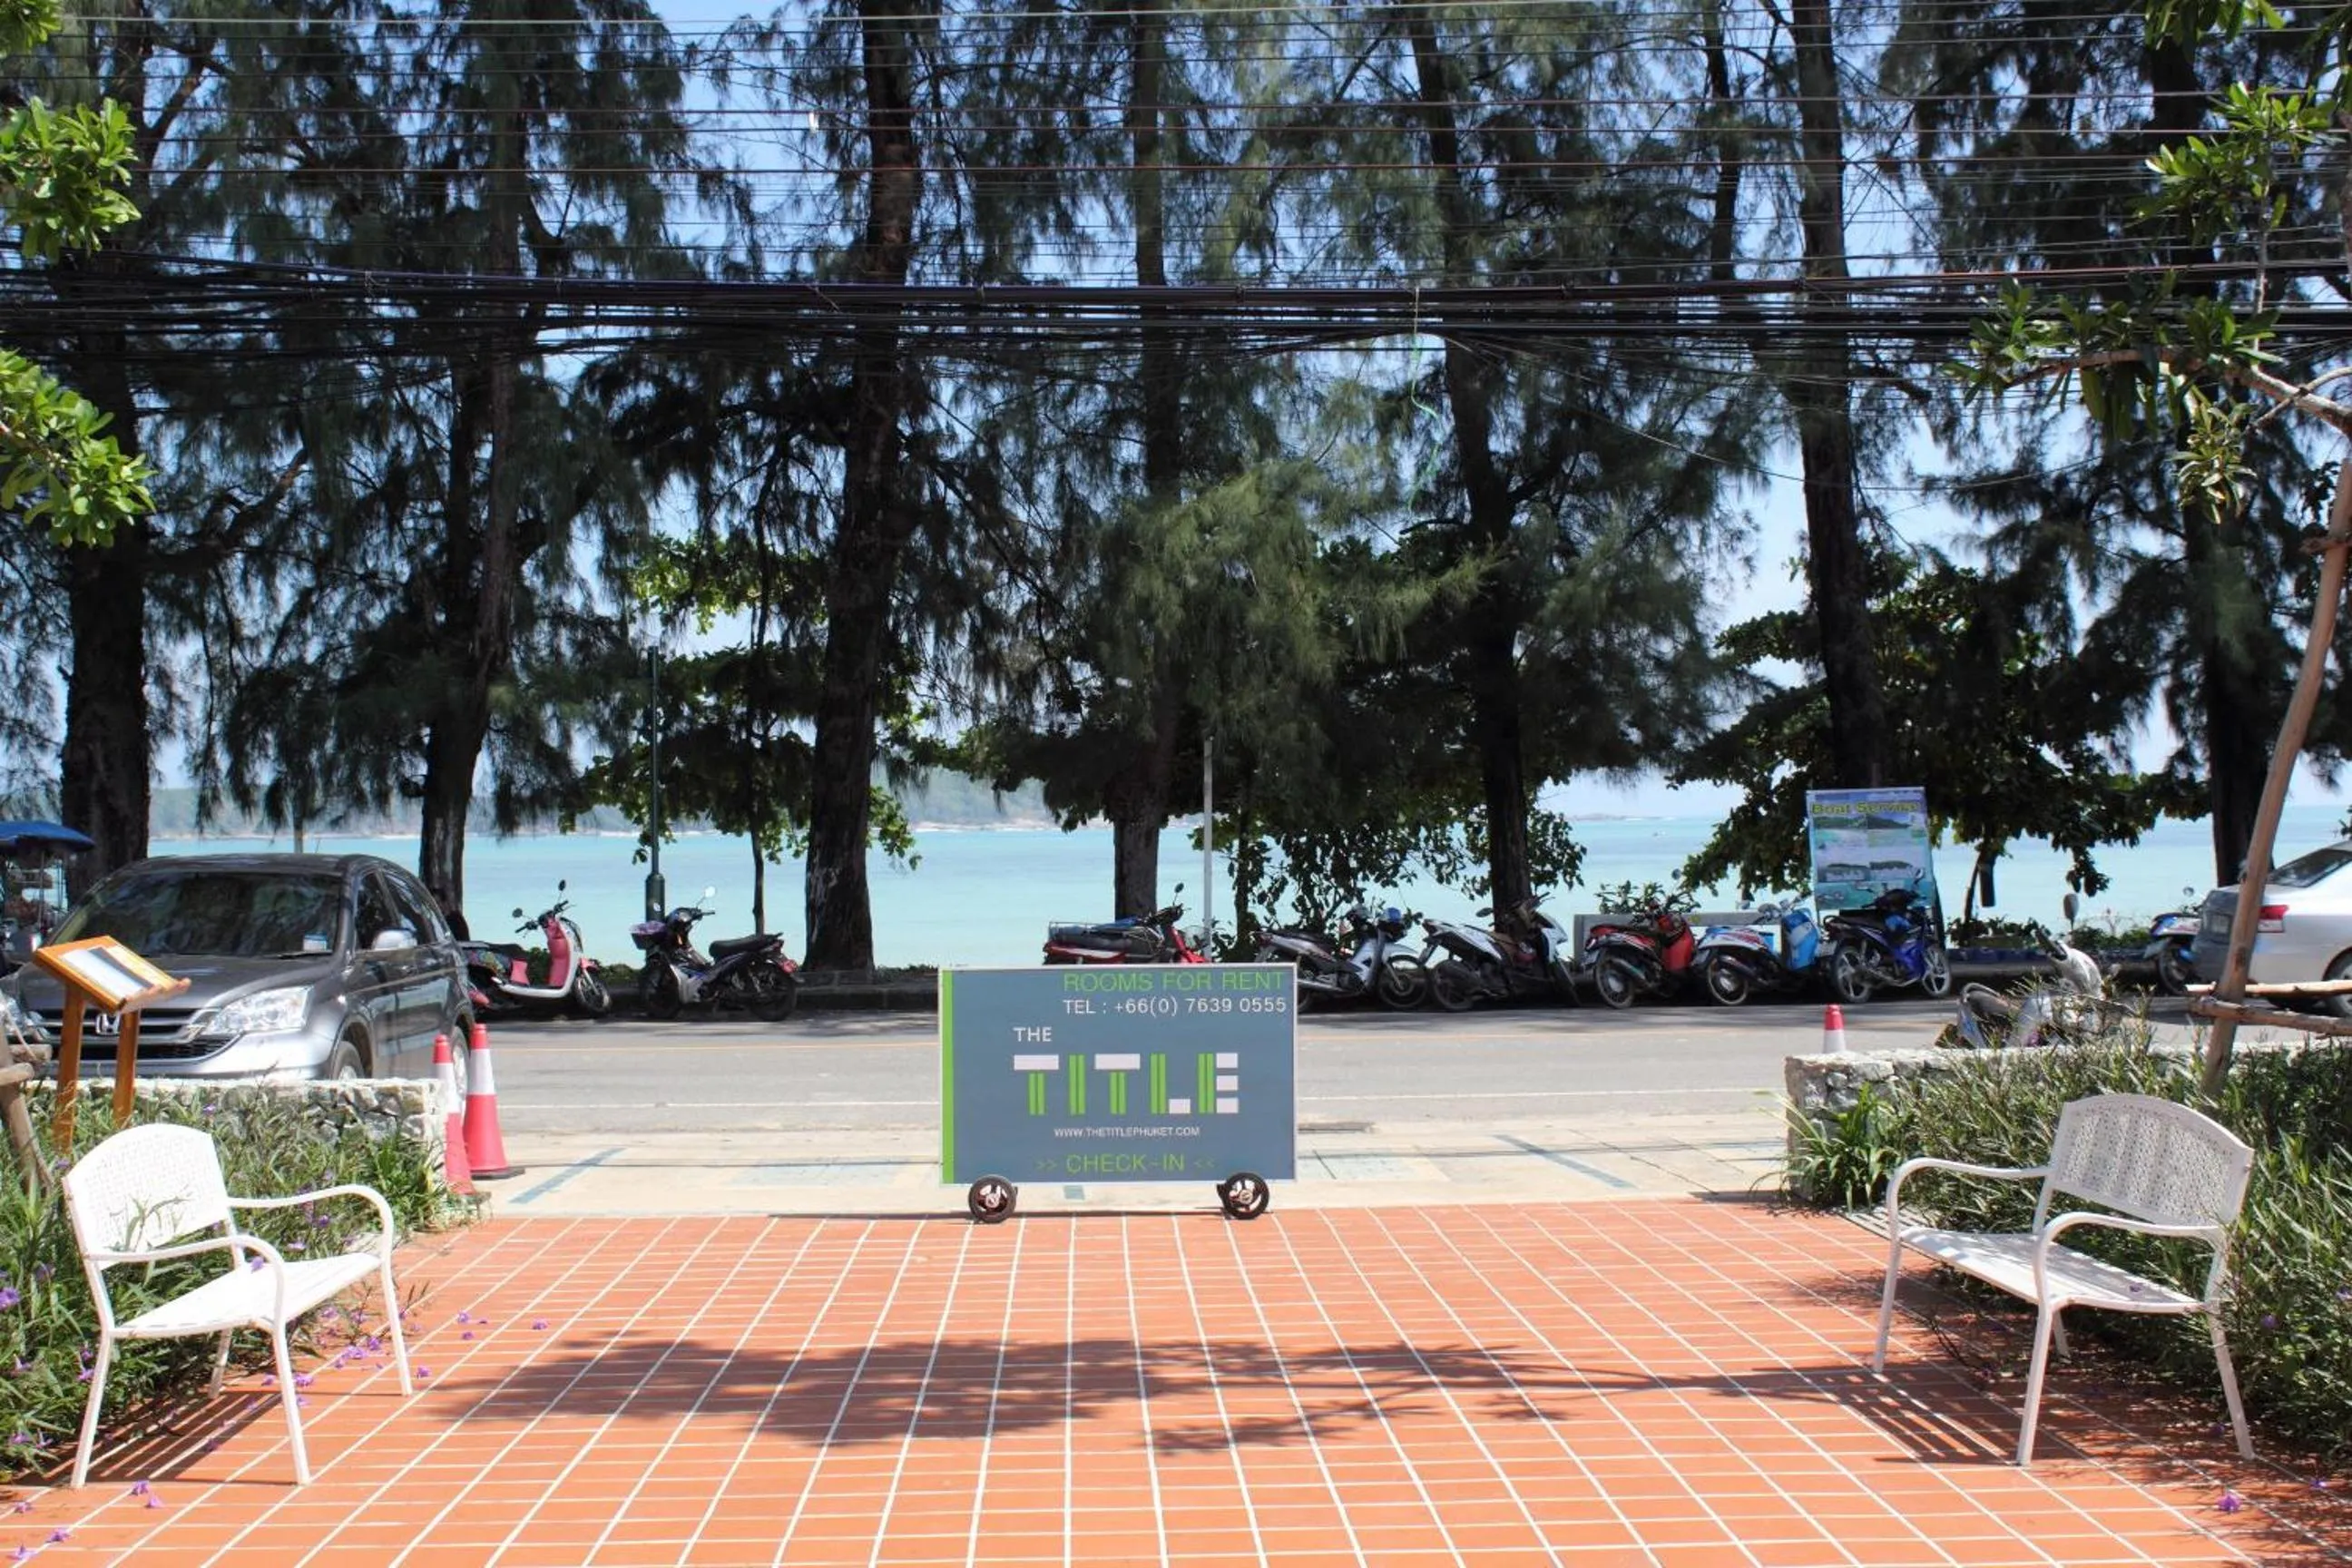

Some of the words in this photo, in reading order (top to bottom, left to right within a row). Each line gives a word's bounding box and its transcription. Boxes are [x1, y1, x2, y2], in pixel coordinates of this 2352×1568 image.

[1063, 972, 1153, 993] ROOMS
[1162, 972, 1212, 992] FOR
[1221, 971, 1284, 991] RENT
[1114, 996, 1179, 1017] +66(0)
[1185, 998, 1232, 1013] 7639
[1239, 997, 1287, 1013] 0555
[1013, 1026, 1053, 1043] THE
[1013, 1053, 1240, 1116] TITLE
[1054, 1126, 1200, 1137] WWW.THETITLEPHUKET.COM
